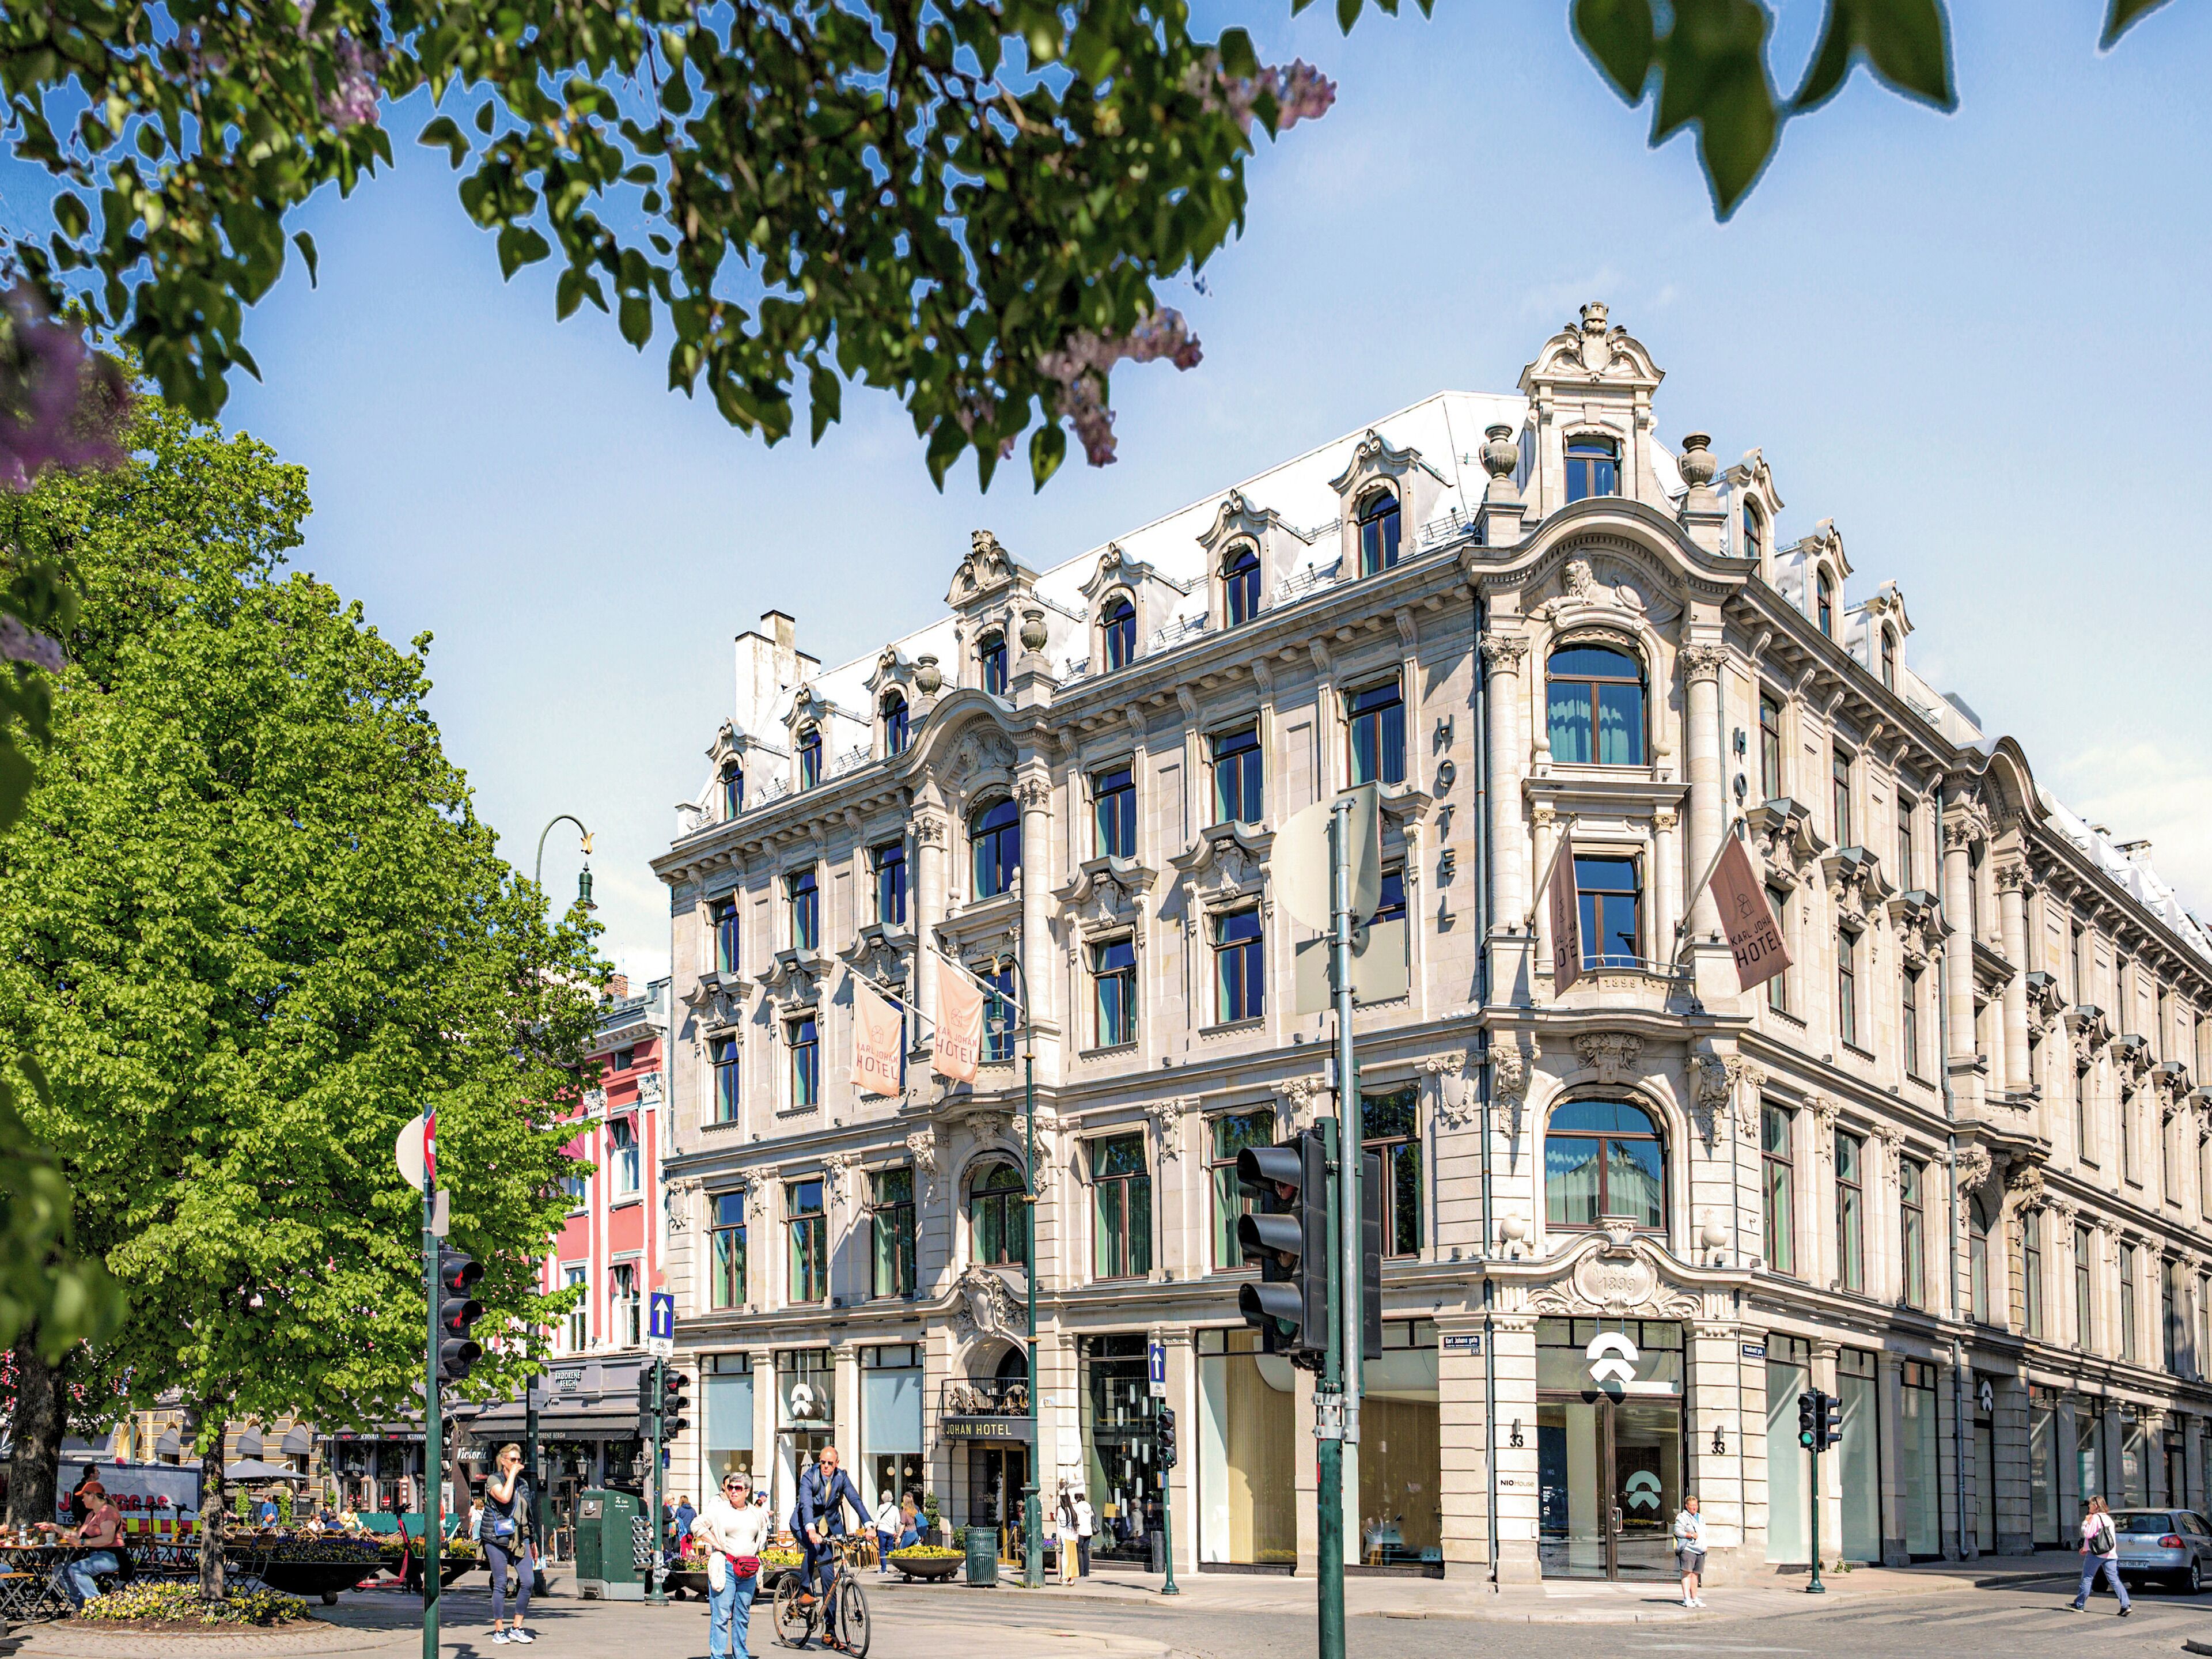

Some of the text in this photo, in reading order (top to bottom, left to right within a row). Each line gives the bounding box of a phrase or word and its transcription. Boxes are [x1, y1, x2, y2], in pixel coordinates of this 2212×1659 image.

[1732, 726, 1748, 841] HOT
[1437, 713, 1457, 921] HOTEL
[1730, 929, 1752, 946] KARL
[1735, 928, 1782, 968] HOTEL
[1604, 978, 1636, 988] 1899
[954, 1033, 977, 1047] JOHAN
[876, 1051, 898, 1064] JOHAN
[935, 1036, 976, 1065] HOTEL
[857, 1054, 898, 1080] HOTEL
[1598, 1277, 1636, 1291] 1899
[1468, 1337, 1478, 1345] gate
[946, 1423, 971, 1435] JOHAN
[976, 1424, 1012, 1435] HOTEL
[1510, 1434, 1524, 1448] 33
[1711, 1441, 1725, 1455] 33
